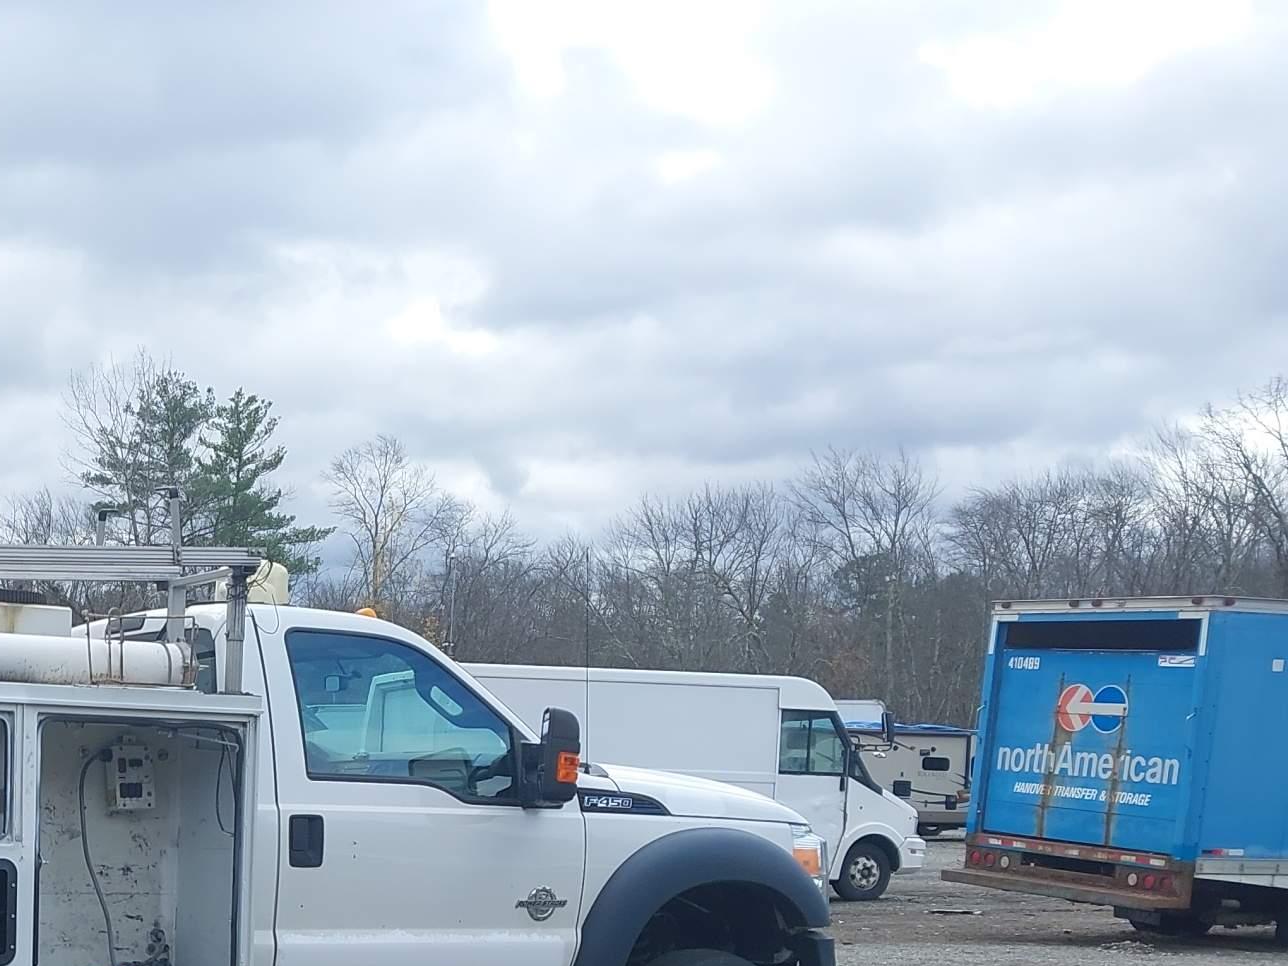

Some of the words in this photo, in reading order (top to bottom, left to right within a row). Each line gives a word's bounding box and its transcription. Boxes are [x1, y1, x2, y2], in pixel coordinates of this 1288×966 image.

[997, 742, 1180, 785] northAmerican
[1053, 785, 1097, 801] TRANSFER
[1098, 790, 1107, 801] &
